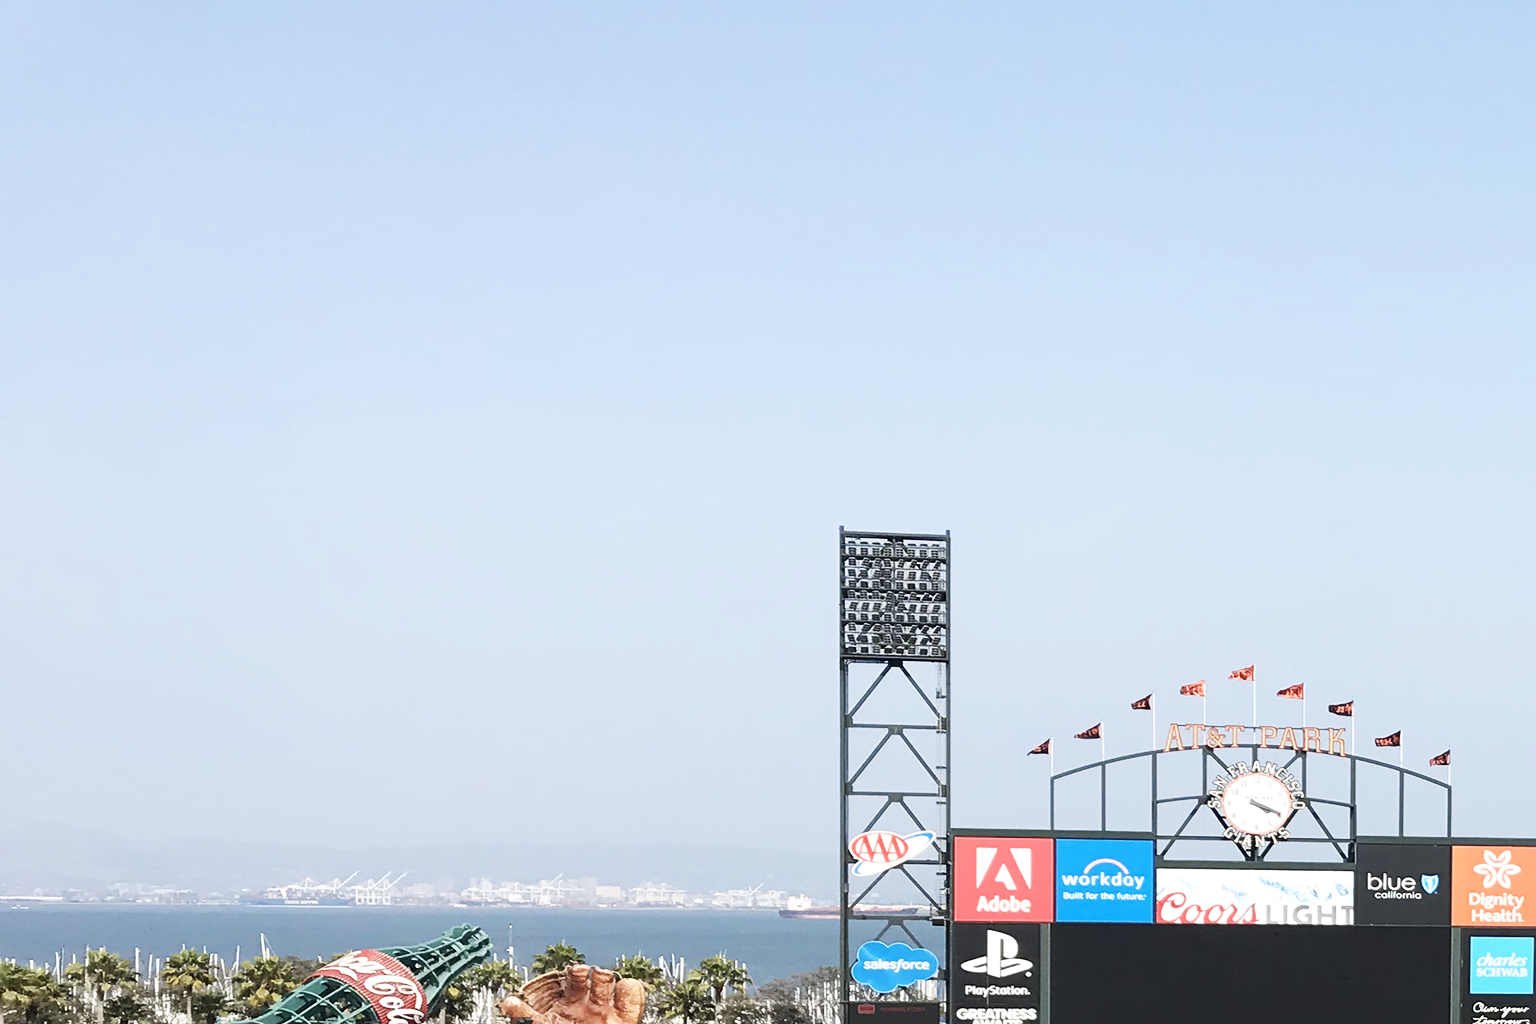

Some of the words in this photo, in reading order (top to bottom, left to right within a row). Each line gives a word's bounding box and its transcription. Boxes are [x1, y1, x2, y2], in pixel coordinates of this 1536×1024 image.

[1163, 723, 1245, 753] AT&T
[1259, 726, 1346, 757] PARK
[1207, 775, 1229, 809] SAN
[1226, 760, 1306, 810] FRANCISCO
[1222, 826, 1291, 848] GIANTS
[857, 832, 901, 863] AAA
[1062, 872, 1145, 889] workday
[1367, 872, 1417, 891] blue
[976, 895, 1031, 912] Adobe
[1063, 892, 1084, 900] Built
[1085, 892, 1099, 900] for
[1100, 892, 1115, 900] the
[1374, 890, 1422, 900] california
[1468, 892, 1525, 909] Dignity
[1156, 892, 1260, 925] Coors
[1266, 905, 1355, 925] LIGHT
[863, 959, 930, 973] salesforce
[1476, 952, 1528, 967] charles
[1476, 967, 1528, 977] SCHWAB
[956, 1008, 1037, 1020] GREATNESS
